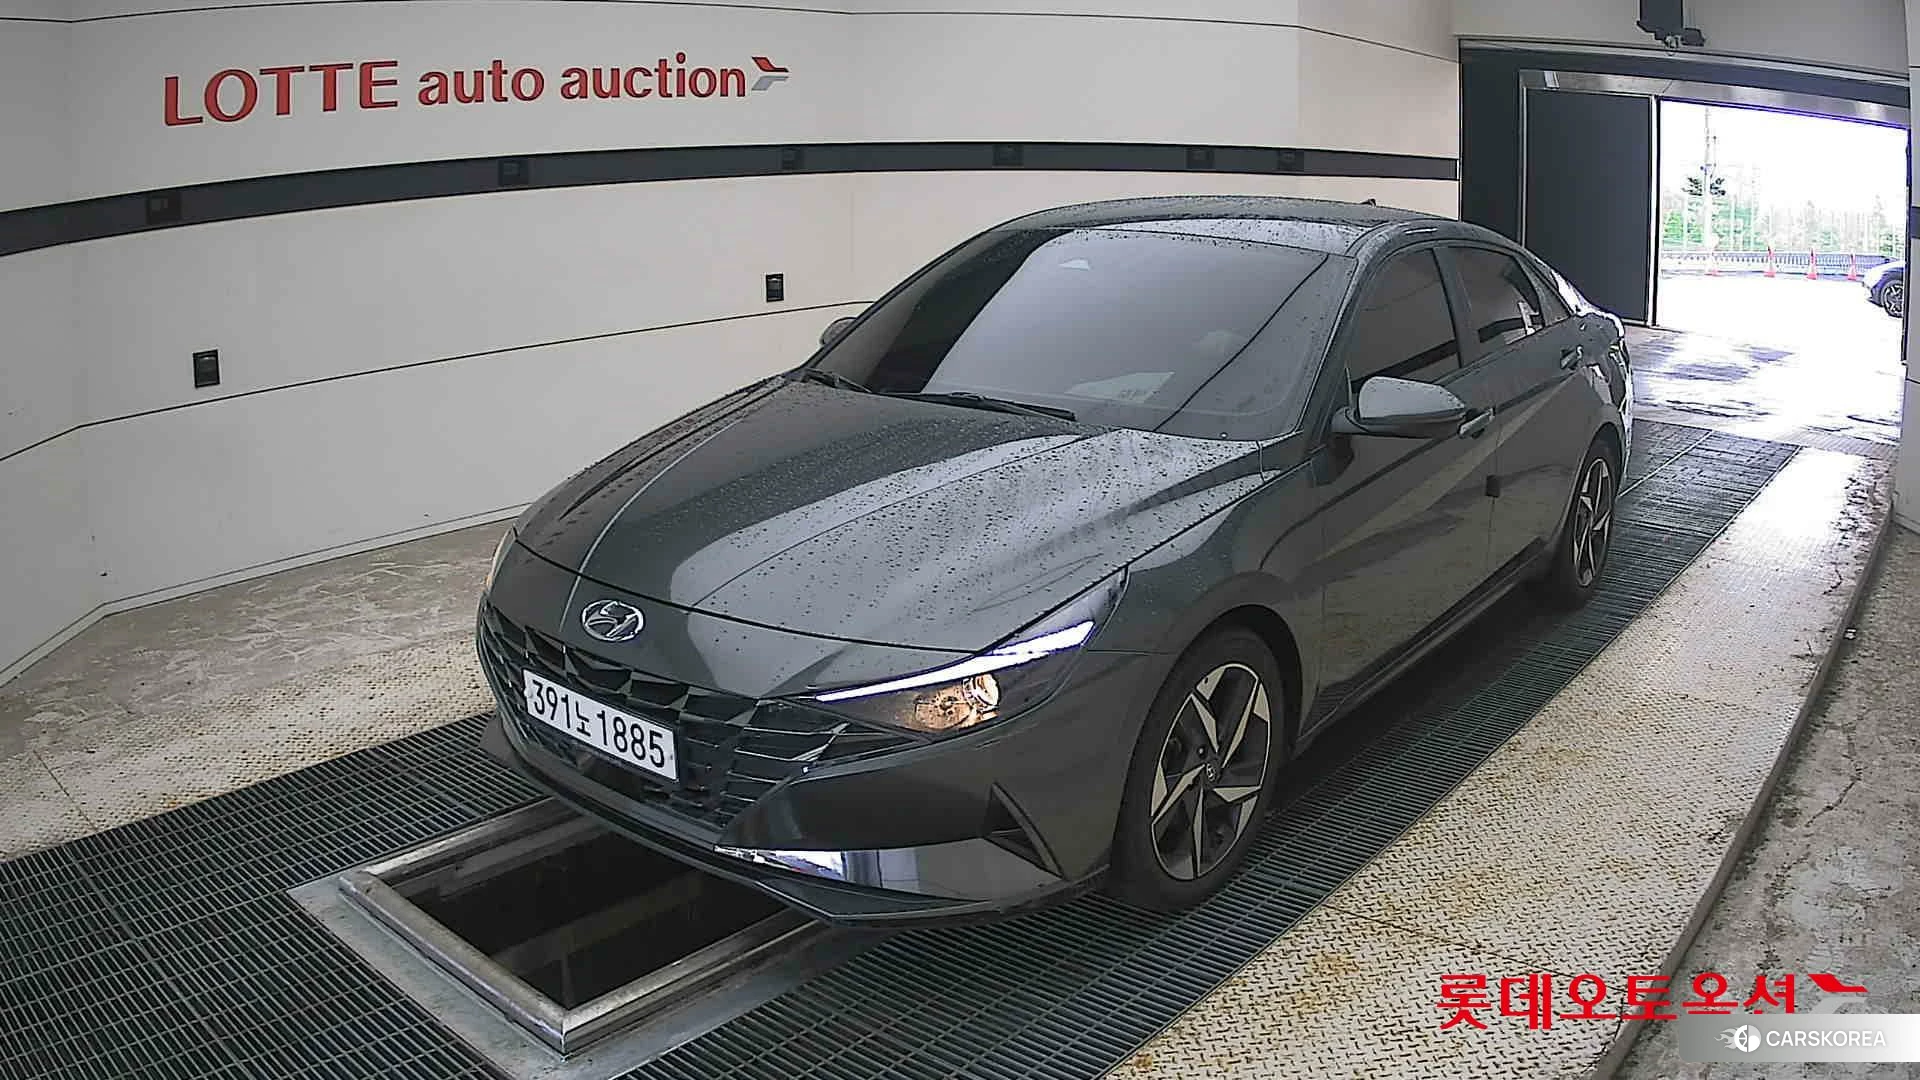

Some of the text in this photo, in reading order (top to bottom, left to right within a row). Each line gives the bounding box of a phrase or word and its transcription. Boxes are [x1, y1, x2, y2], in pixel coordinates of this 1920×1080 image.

[164, 51, 747, 127] LOTTE auto auction
